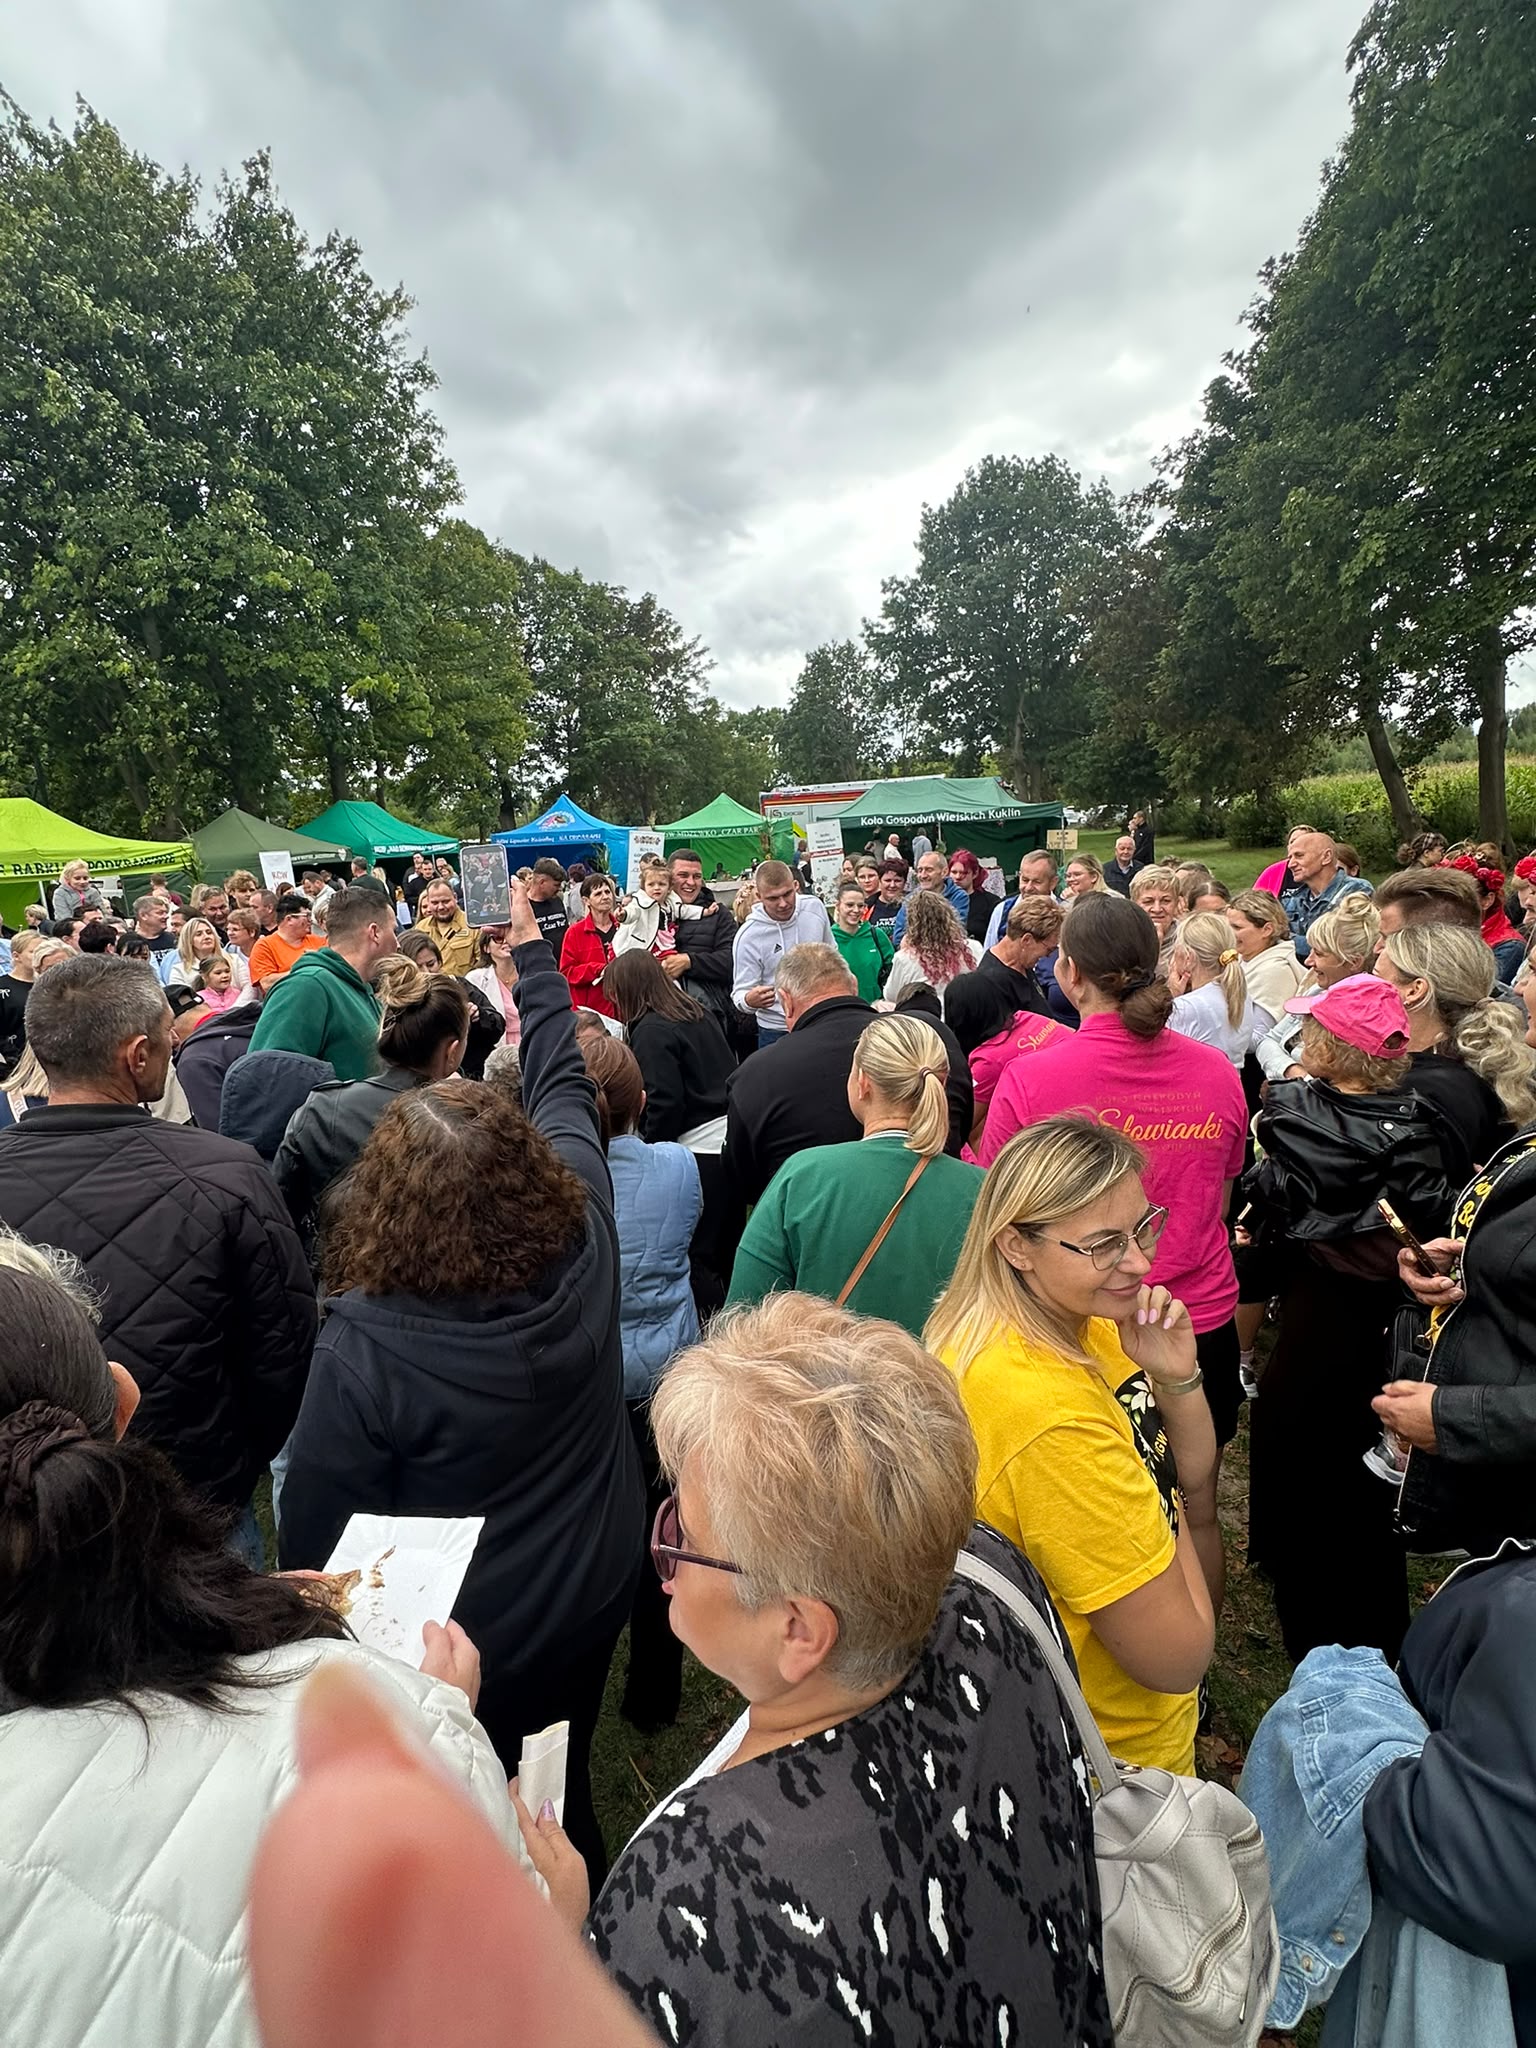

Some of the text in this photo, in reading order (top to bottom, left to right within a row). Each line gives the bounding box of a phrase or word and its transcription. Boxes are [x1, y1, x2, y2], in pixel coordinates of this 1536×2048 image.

[861, 808, 1021, 826] Koło Gospodyń Wiejskich Kuklin
